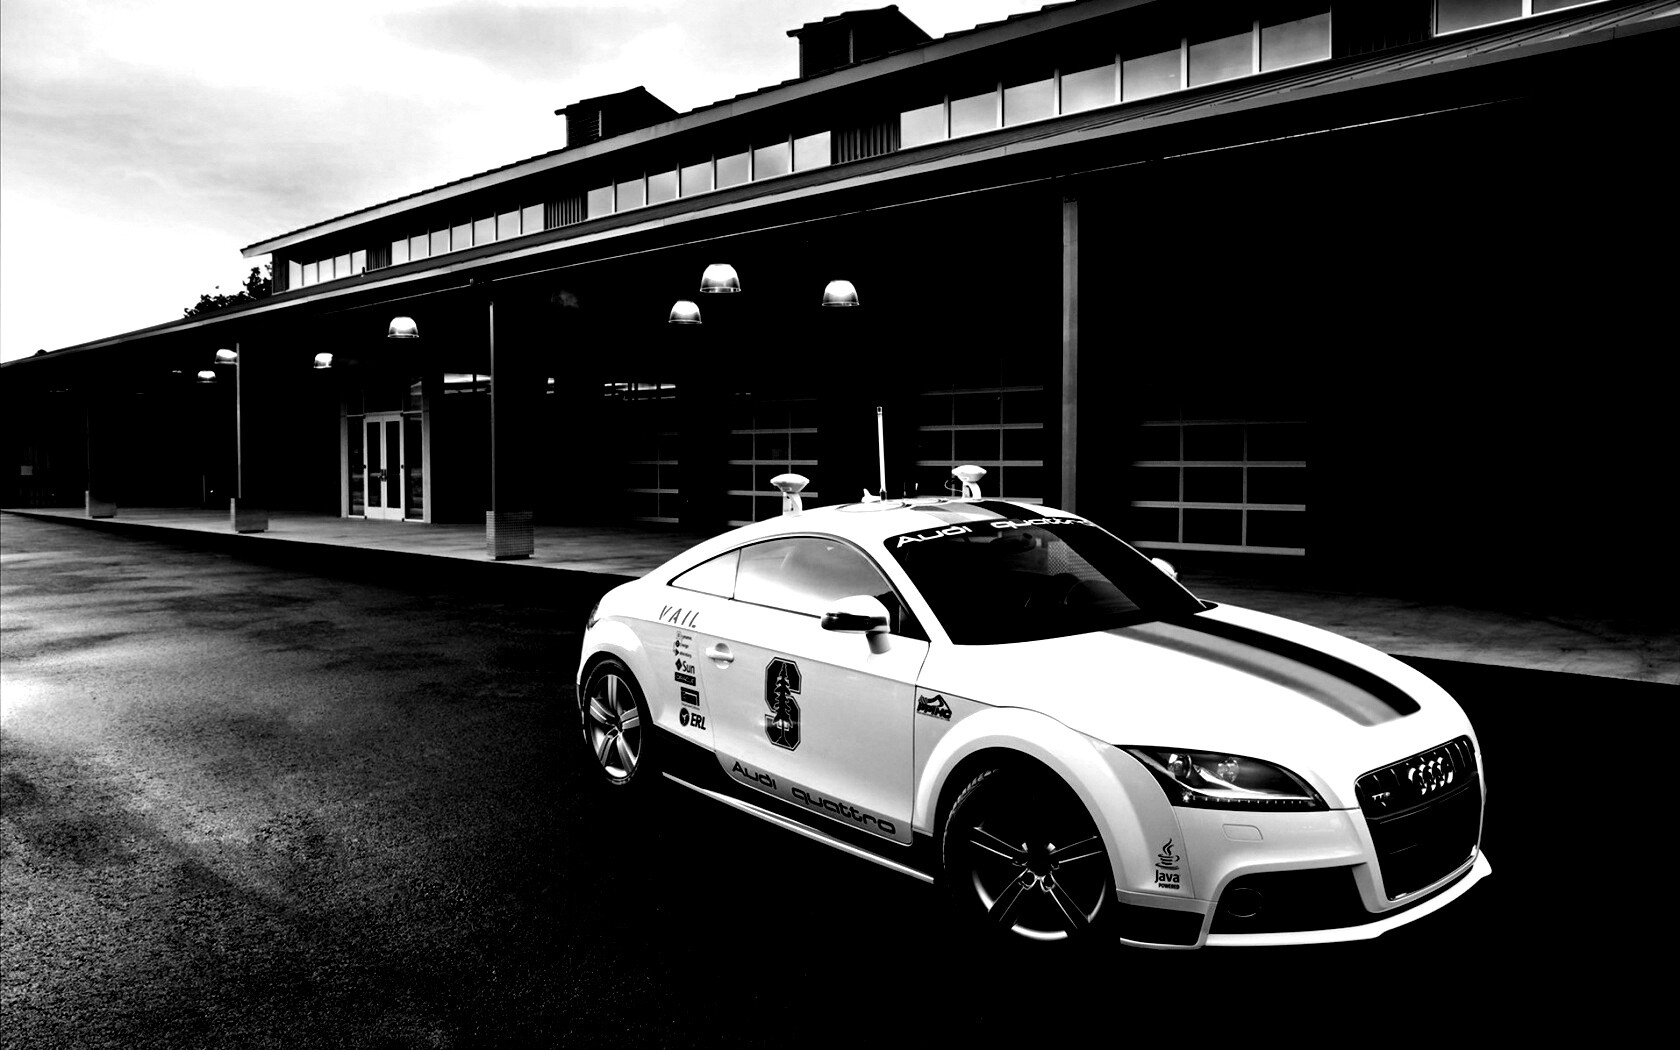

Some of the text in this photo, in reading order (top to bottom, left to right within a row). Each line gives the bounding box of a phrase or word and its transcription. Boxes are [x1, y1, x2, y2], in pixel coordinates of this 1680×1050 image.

[896, 525, 973, 548] Audi
[659, 605, 699, 628] VAIL
[682, 661, 695, 675] Sun
[690, 712, 707, 730] ERL
[732, 761, 896, 835] Audi quattro
[1154, 869, 1180, 883] Java
